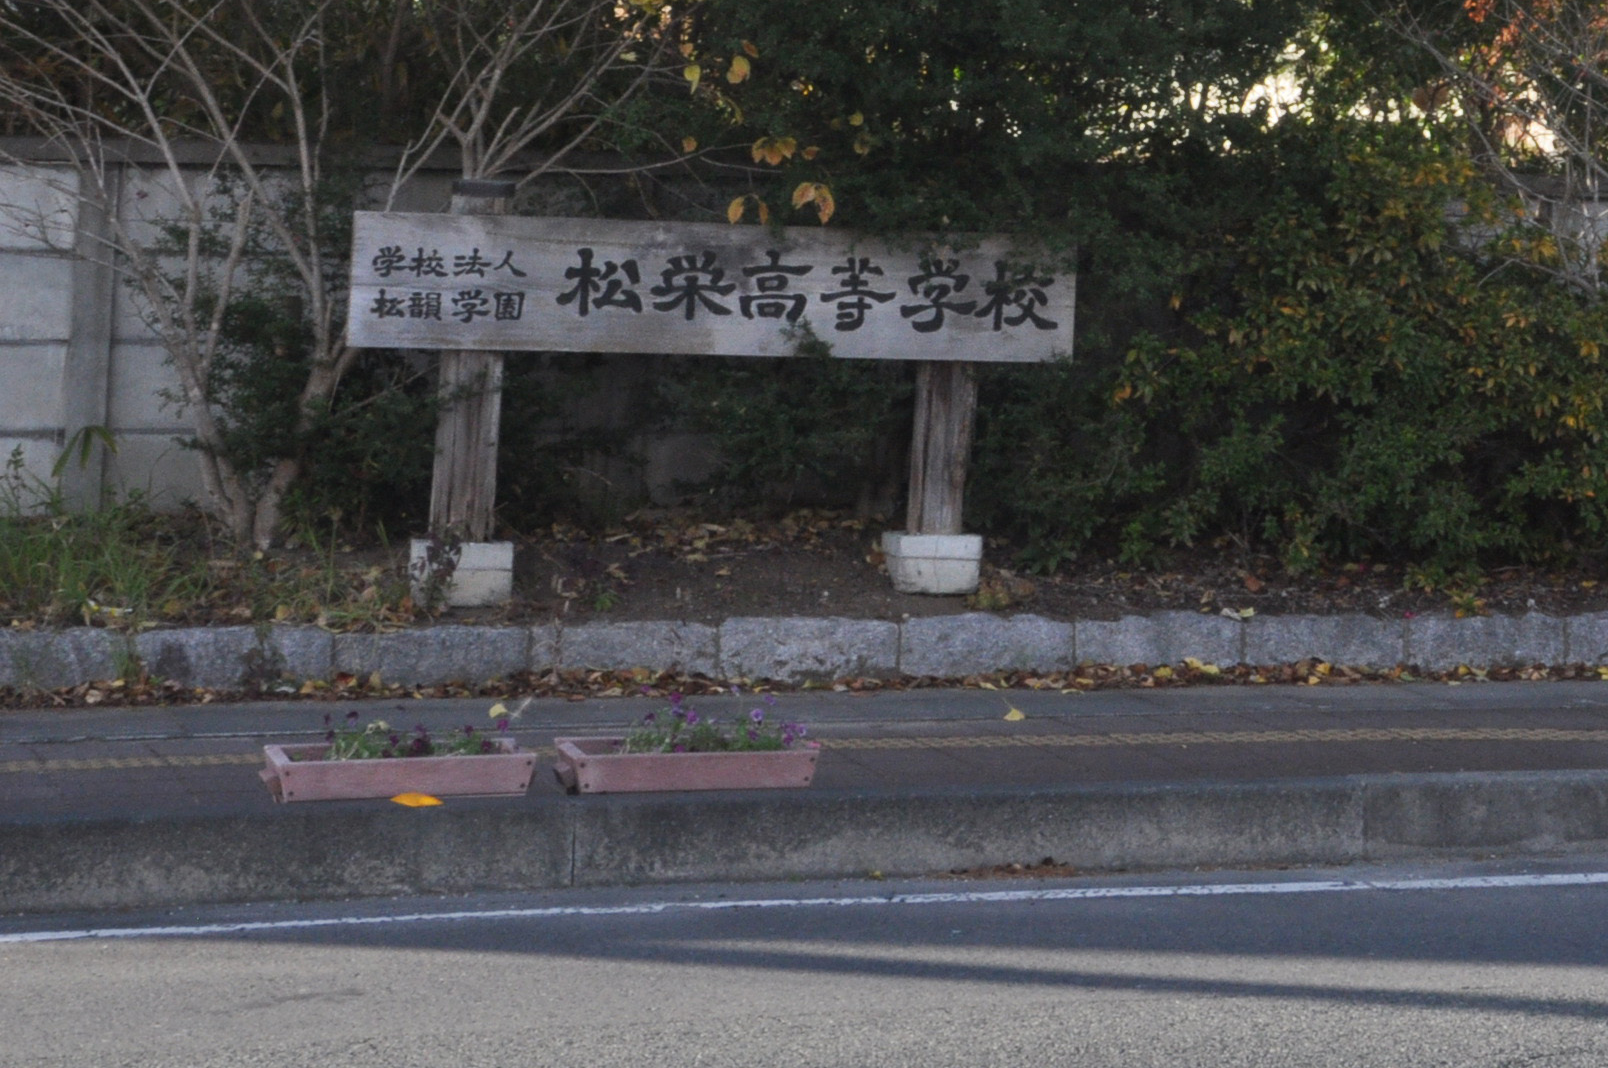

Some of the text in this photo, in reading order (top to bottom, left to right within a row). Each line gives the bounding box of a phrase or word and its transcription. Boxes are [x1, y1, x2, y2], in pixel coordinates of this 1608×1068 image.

[372, 246, 527, 278] 学校法人
[370, 289, 525, 323] 松韻学園
[556, 247, 1058, 333] 松栄高等学校
